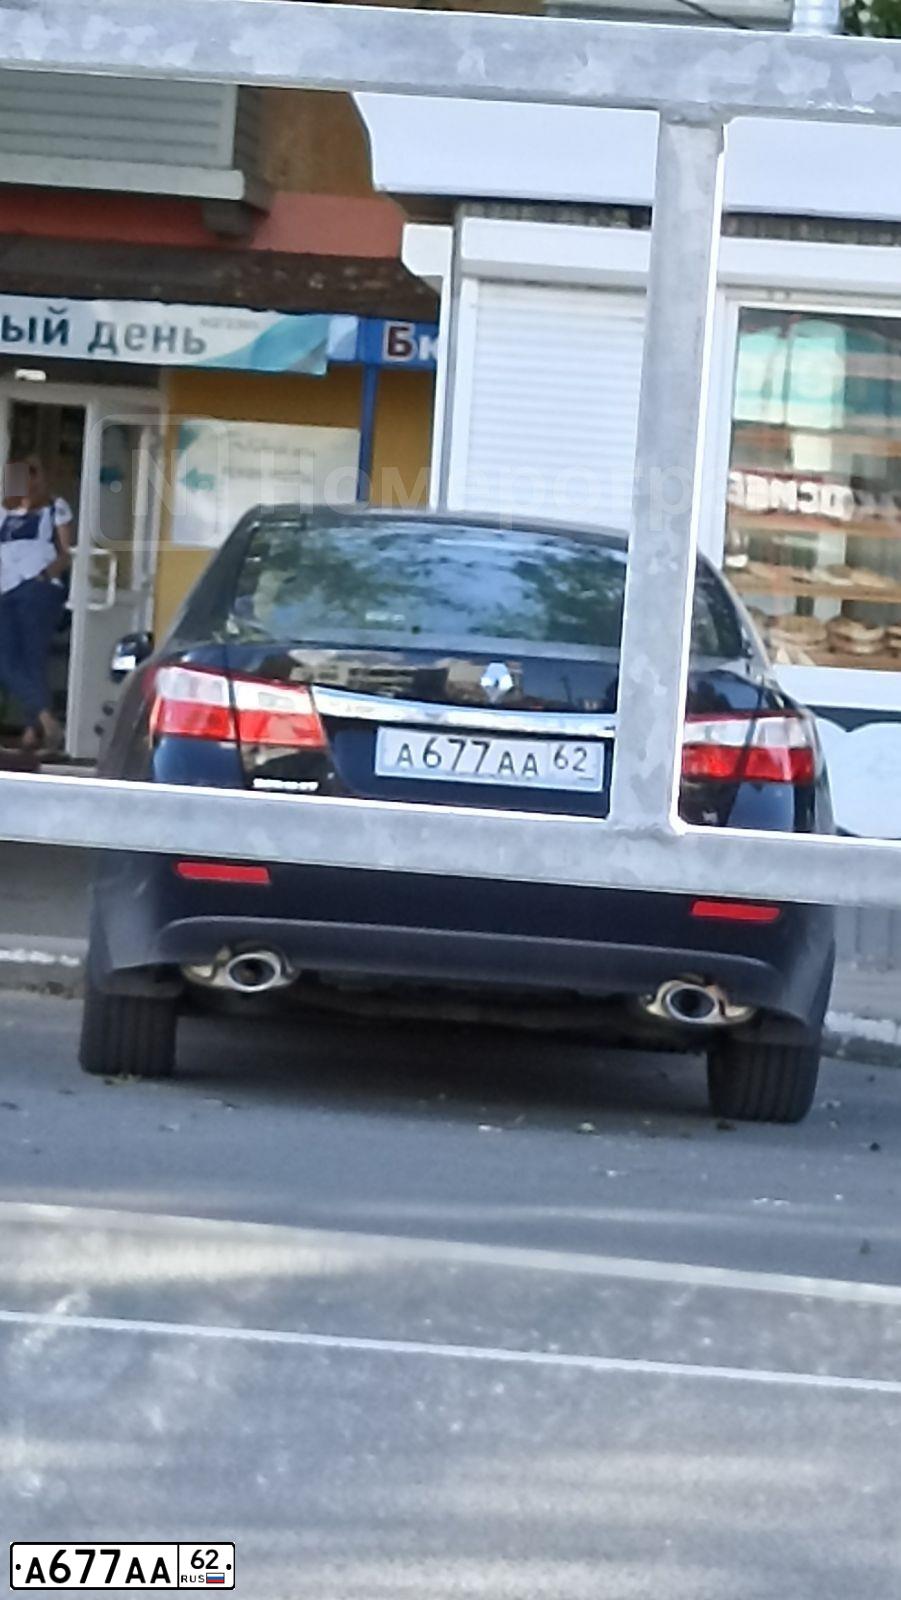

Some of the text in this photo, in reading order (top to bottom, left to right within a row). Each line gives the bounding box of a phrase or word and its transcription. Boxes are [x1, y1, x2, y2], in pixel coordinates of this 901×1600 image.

[1, 305, 207, 355] ый день
[396, 737, 587, 776] А677АА 62
